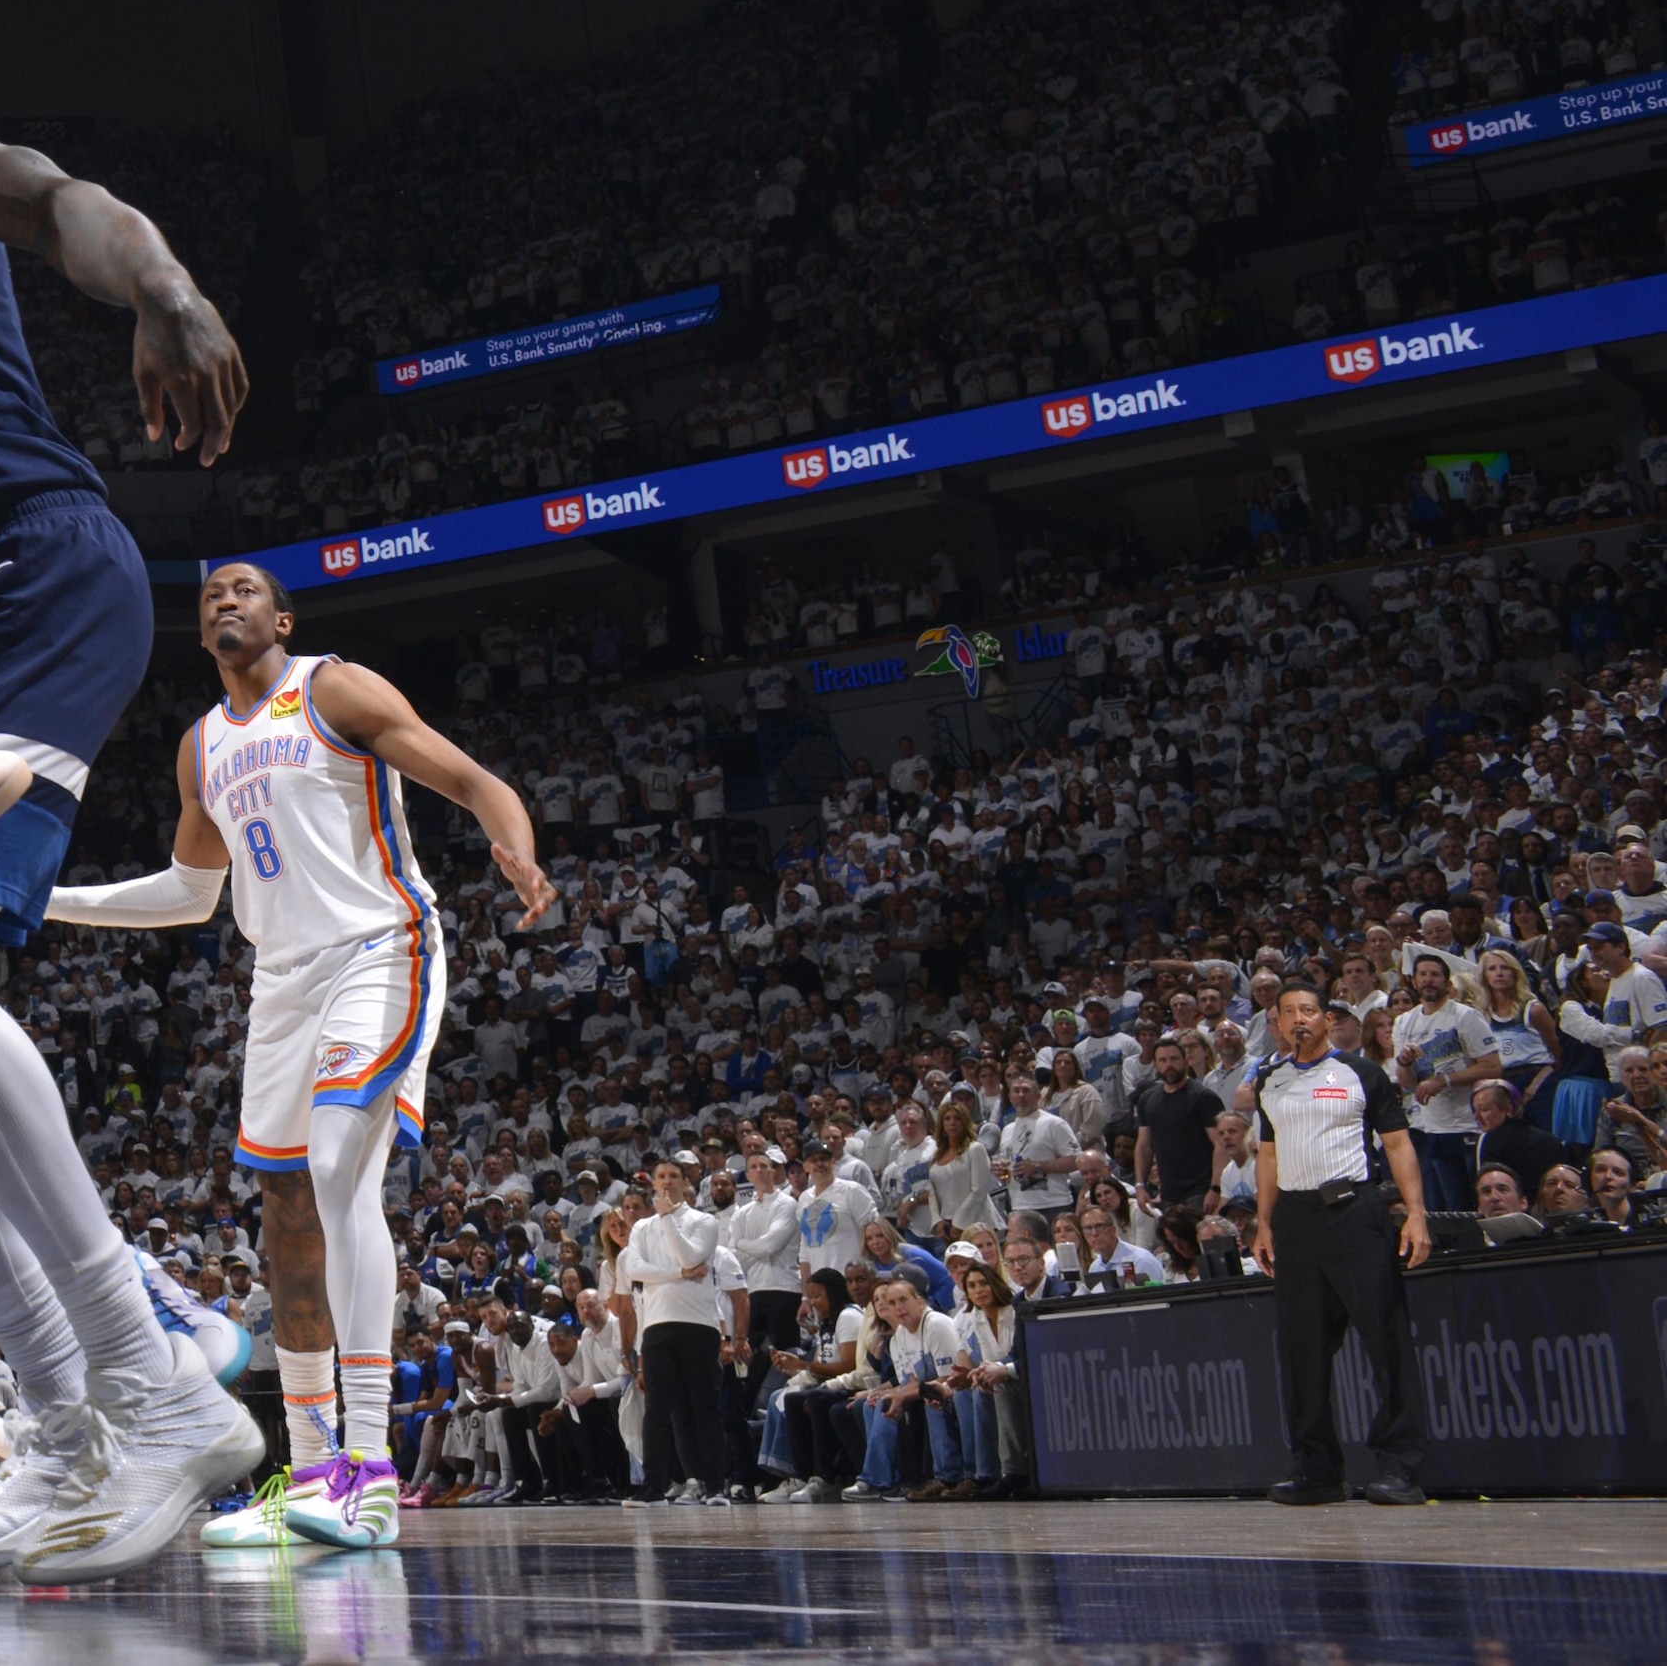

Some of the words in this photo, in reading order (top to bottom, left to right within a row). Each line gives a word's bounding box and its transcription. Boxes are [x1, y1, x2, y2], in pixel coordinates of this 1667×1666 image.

[1559, 94, 1597, 111] Step
[1602, 88, 1622, 103] up
[1626, 78, 1663, 97] your
[1563, 112, 1598, 128] U.S.
[1600, 99, 1643, 121] Bank
[1432, 130, 1463, 149] us
[486, 338, 514, 353] Step
[516, 333, 532, 348] up
[533, 329, 561, 346] your
[562, 321, 596, 338] game
[598, 311, 625, 328] with
[488, 352, 512, 367] U.S.
[515, 346, 545, 363] Bank
[1329, 347, 1374, 376] us
[396, 363, 418, 381] us
[1046, 403, 1087, 431] us
[785, 456, 825, 481] us
[546, 502, 582, 527] us
[323, 545, 357, 571] us
[807, 657, 908, 695] Treasure
[205, 735, 312, 809] OKLAHOMA
[226, 772, 273, 822] CITY
[242, 816, 284, 882] 8
[1502, 1039, 1513, 1055] 5
[1314, 1089, 1347, 1098] Emirates
[1041, 1349, 1253, 1453] NBATickets.com
